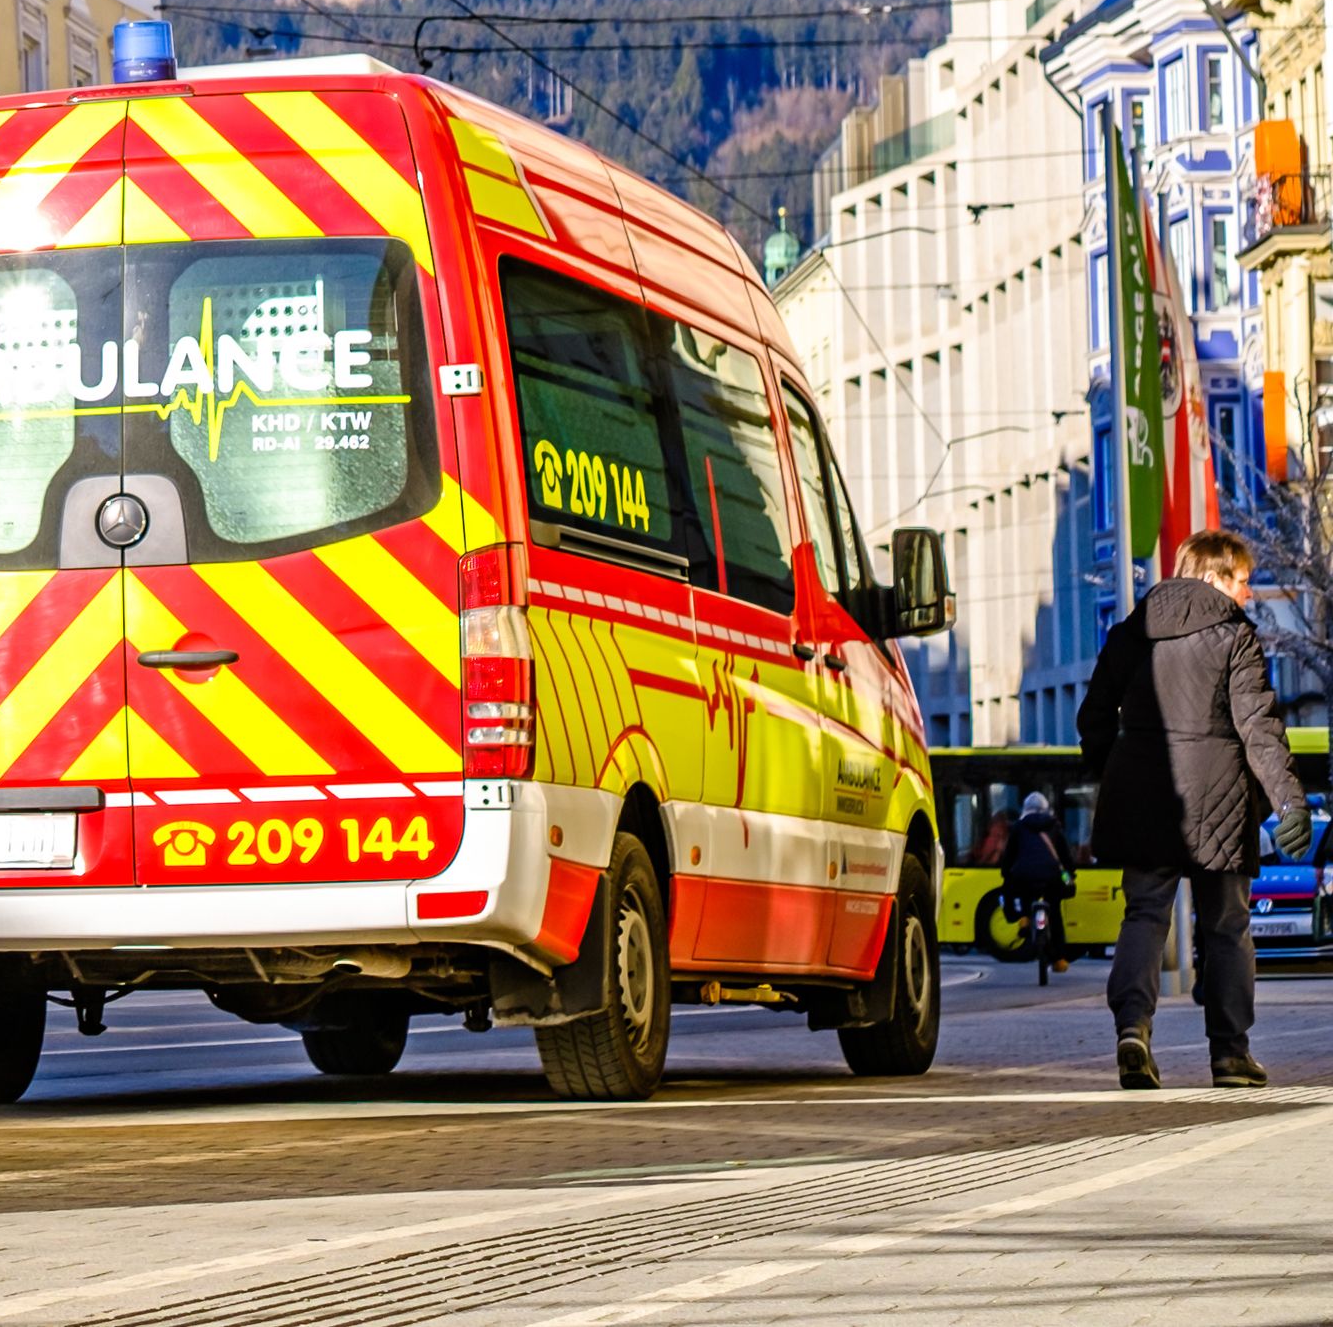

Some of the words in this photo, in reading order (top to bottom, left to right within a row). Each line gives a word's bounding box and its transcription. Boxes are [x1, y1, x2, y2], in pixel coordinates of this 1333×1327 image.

[252, 413, 301, 433] KHD
[320, 411, 373, 431] KTW
[314, 434, 370, 450] 29.462
[566, 449, 607, 521] 209
[610, 462, 650, 533] 144
[227, 817, 324, 865] 209
[340, 816, 435, 862] 144
